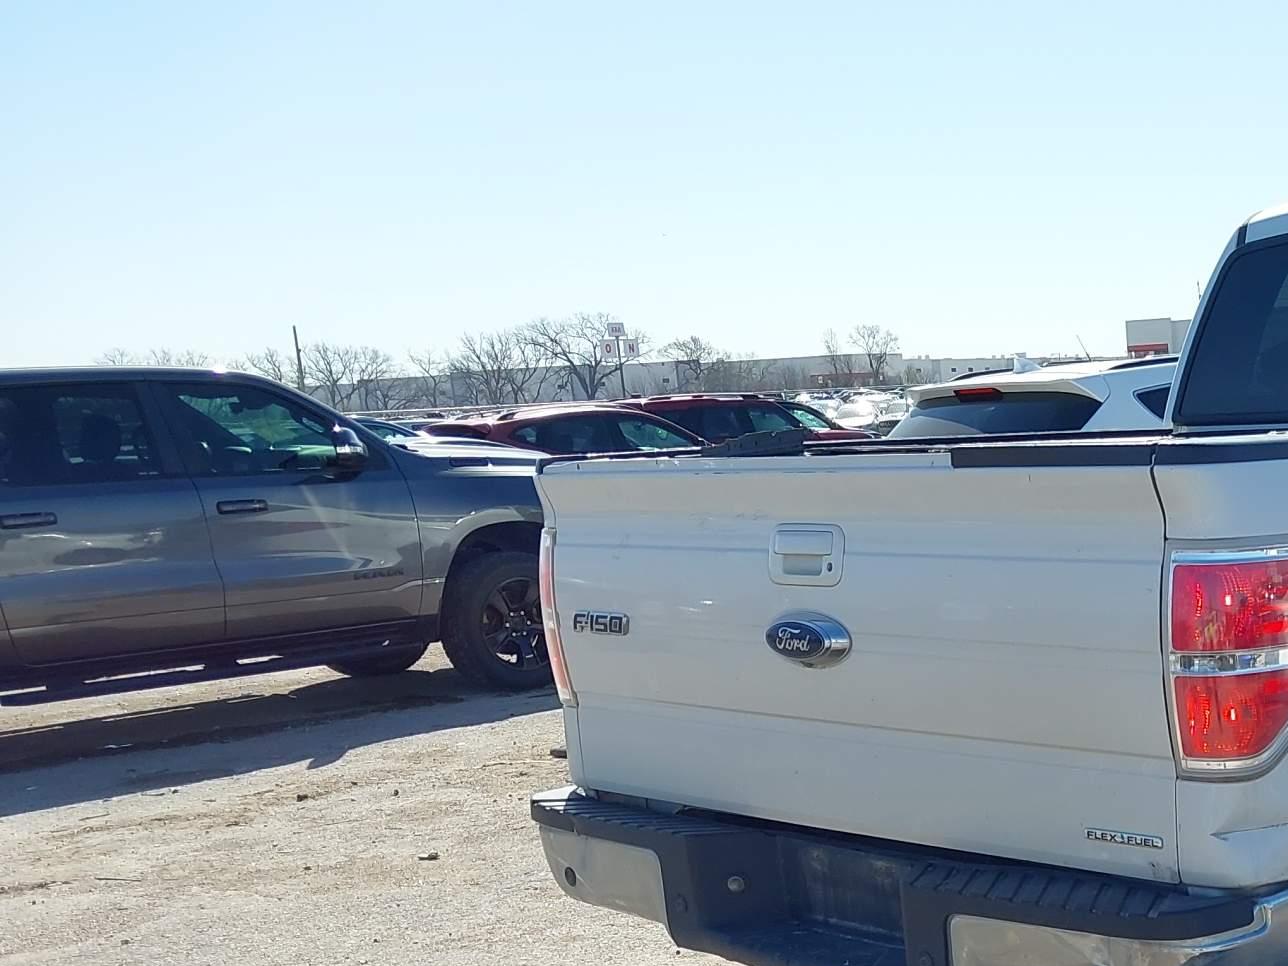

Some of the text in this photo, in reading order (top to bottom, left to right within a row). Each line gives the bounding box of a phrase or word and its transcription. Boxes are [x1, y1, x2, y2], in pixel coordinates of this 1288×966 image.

[573, 611, 628, 634] F-150
[775, 626, 811, 652] Ford
[1086, 830, 1160, 849] FLEX FUEL
